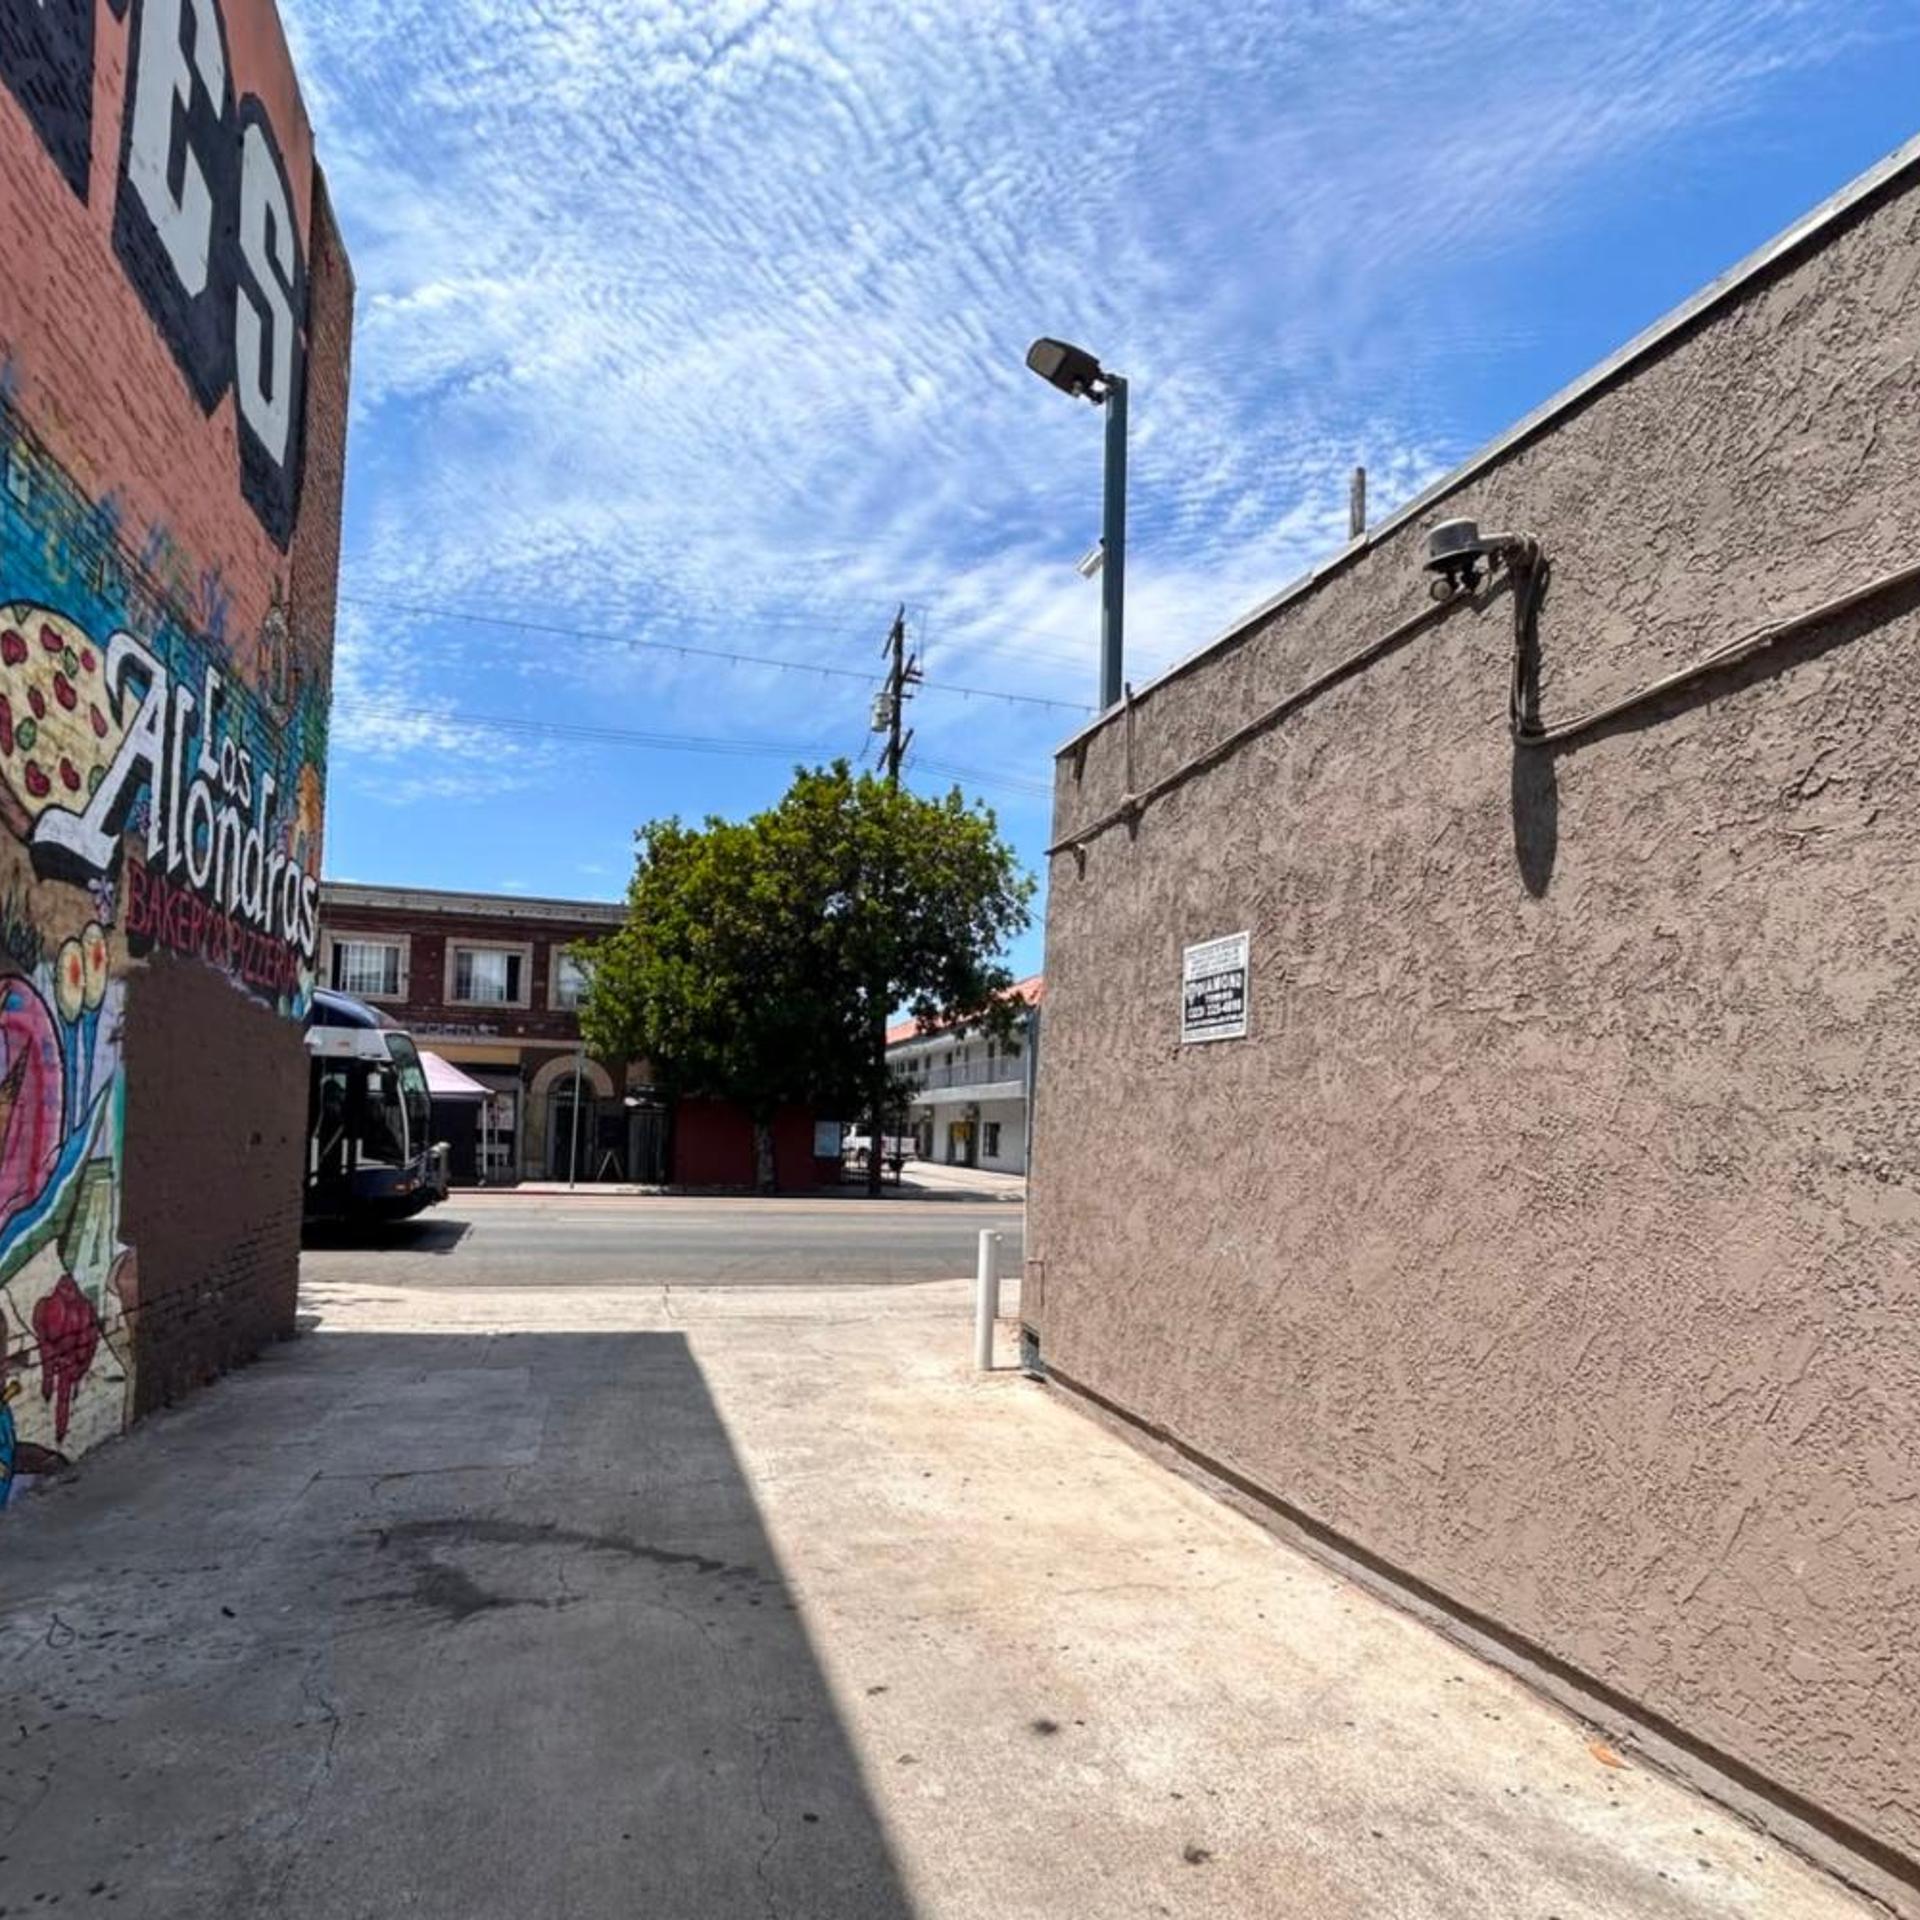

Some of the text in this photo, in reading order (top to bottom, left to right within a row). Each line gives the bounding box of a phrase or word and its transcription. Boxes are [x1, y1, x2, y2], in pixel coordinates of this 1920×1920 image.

[33, 632, 318, 958] Alondras
[201, 665, 252, 809] Los
[127, 857, 212, 962] BAKERY
[227, 916, 299, 992] PIZZERIA
